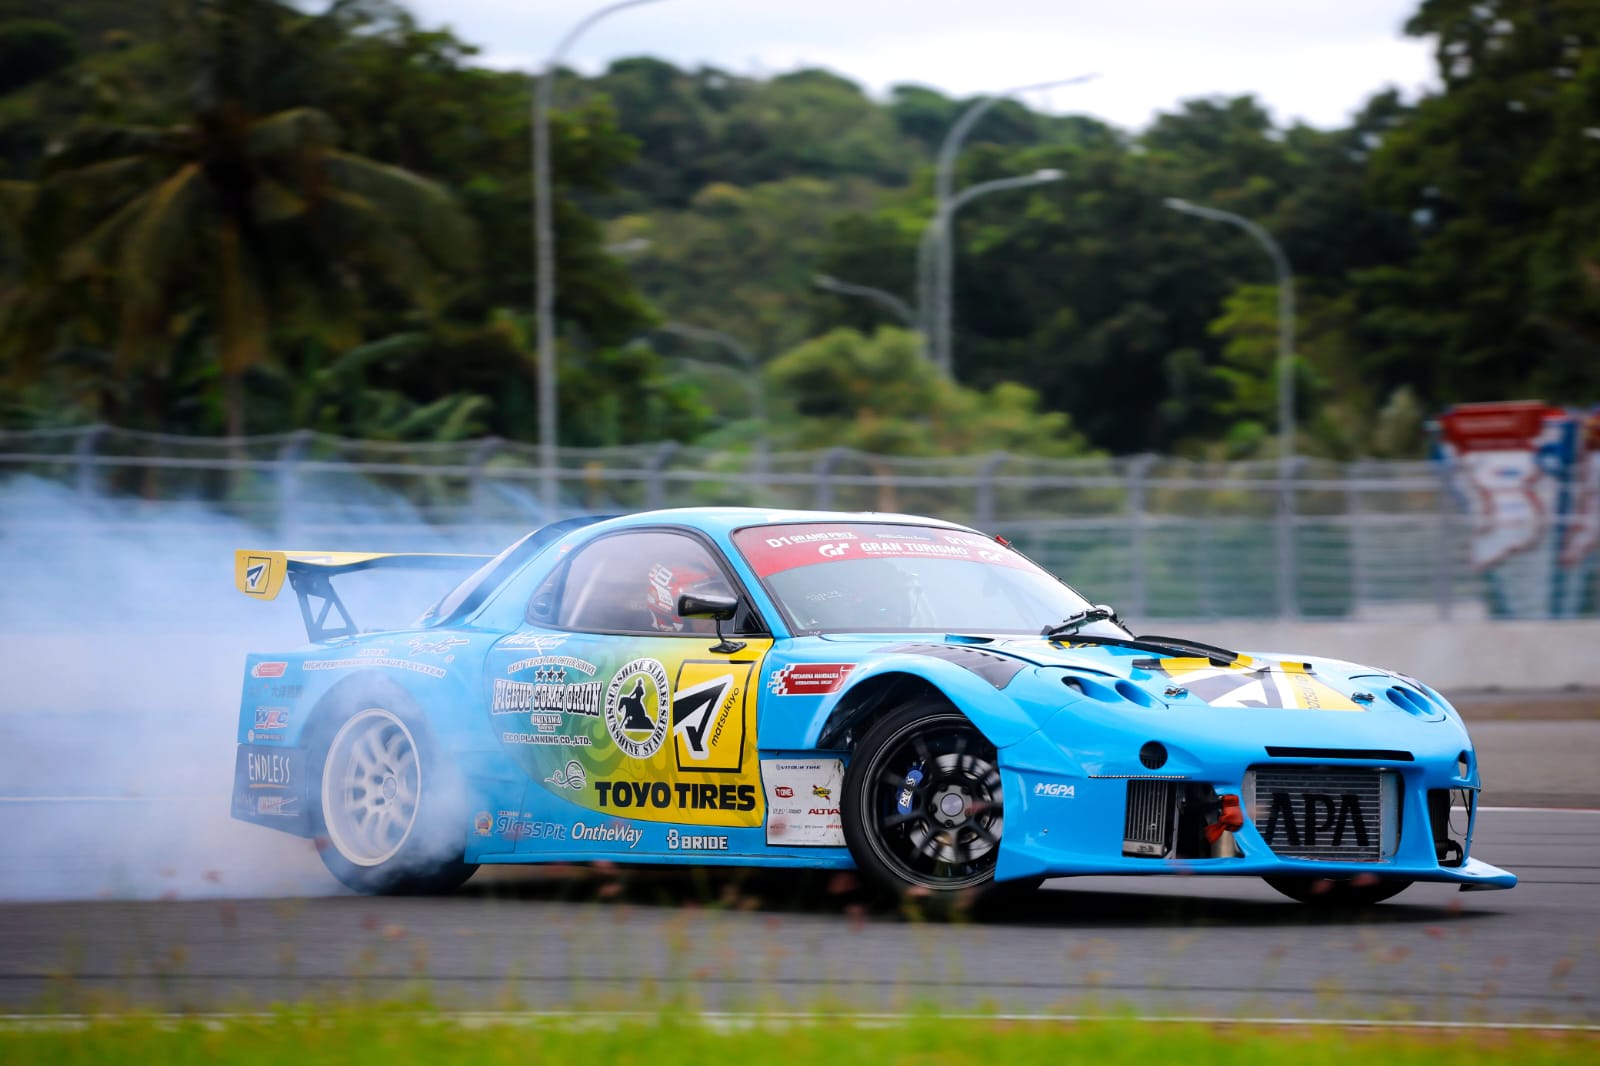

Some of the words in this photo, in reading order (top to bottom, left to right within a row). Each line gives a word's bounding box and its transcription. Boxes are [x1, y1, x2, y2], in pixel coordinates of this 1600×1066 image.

[766, 536, 792, 548] D1
[790, 534, 827, 543] GRAND
[860, 542, 902, 552] GRAN
[904, 543, 968, 556] TURISMO
[493, 680, 533, 714] PICKUP
[534, 684, 565, 712] SOME
[566, 681, 602, 716] ORION
[711, 687, 739, 746] matsukiyo
[520, 734, 559, 744] PLANNING
[248, 753, 290, 784] ENDLESS
[595, 781, 671, 809] TOYO
[675, 783, 755, 811] TIRES
[1034, 782, 1075, 797] MGPA
[1265, 792, 1370, 847] APA
[681, 836, 728, 850] BRIDE
